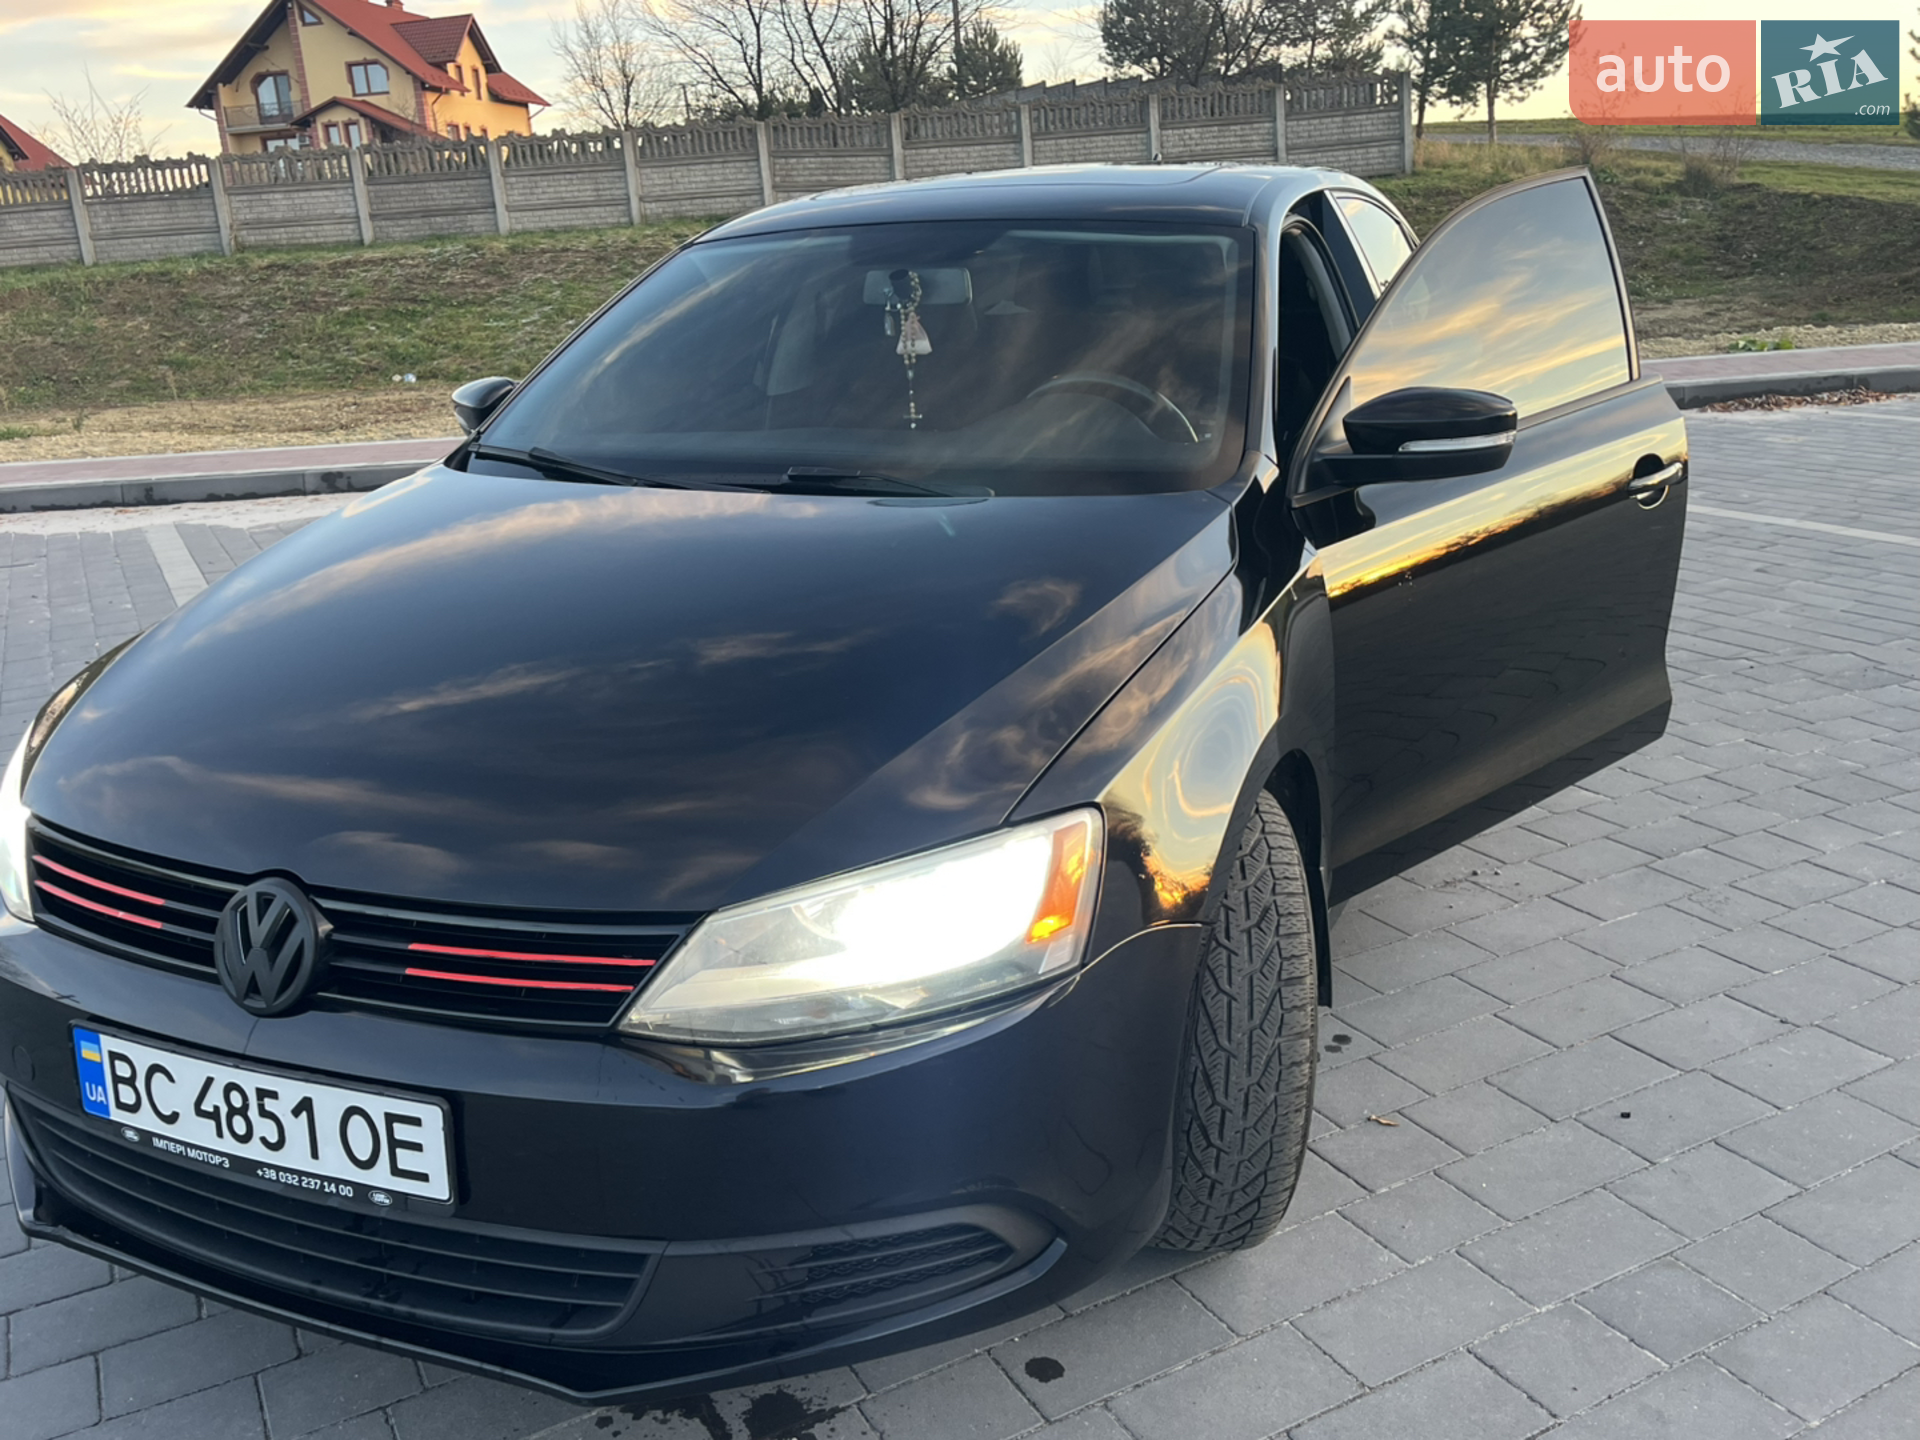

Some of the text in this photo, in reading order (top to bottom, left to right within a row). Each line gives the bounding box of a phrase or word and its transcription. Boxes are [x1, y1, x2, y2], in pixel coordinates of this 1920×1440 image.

[85, 1081, 108, 1105] UA
[107, 1049, 430, 1184] BC 4851 OE
[256, 1167, 354, 1198] +38 032 237 14 00
